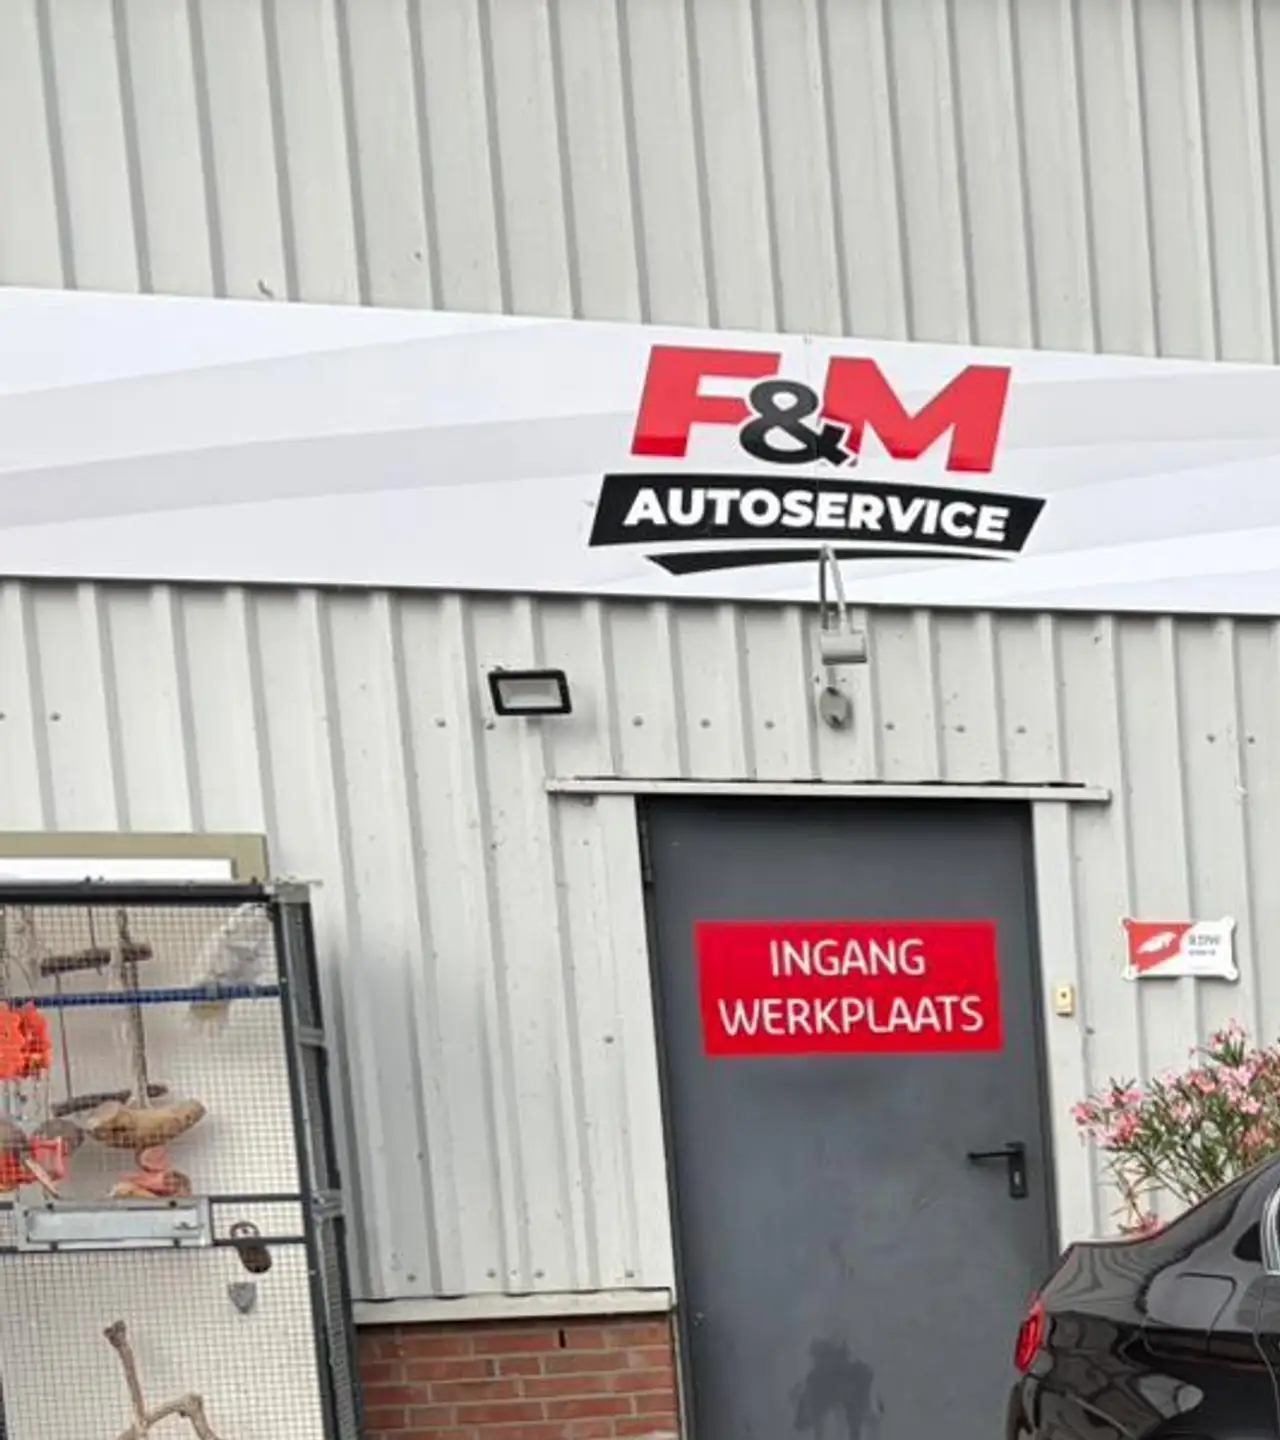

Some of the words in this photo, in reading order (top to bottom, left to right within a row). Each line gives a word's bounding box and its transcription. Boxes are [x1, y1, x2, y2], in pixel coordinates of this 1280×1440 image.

[631, 344, 1011, 474] F&M
[623, 487, 1011, 542] AUTOSERVICE
[769, 938, 926, 977] INGANG
[717, 995, 984, 1036] WERKPLAATS
